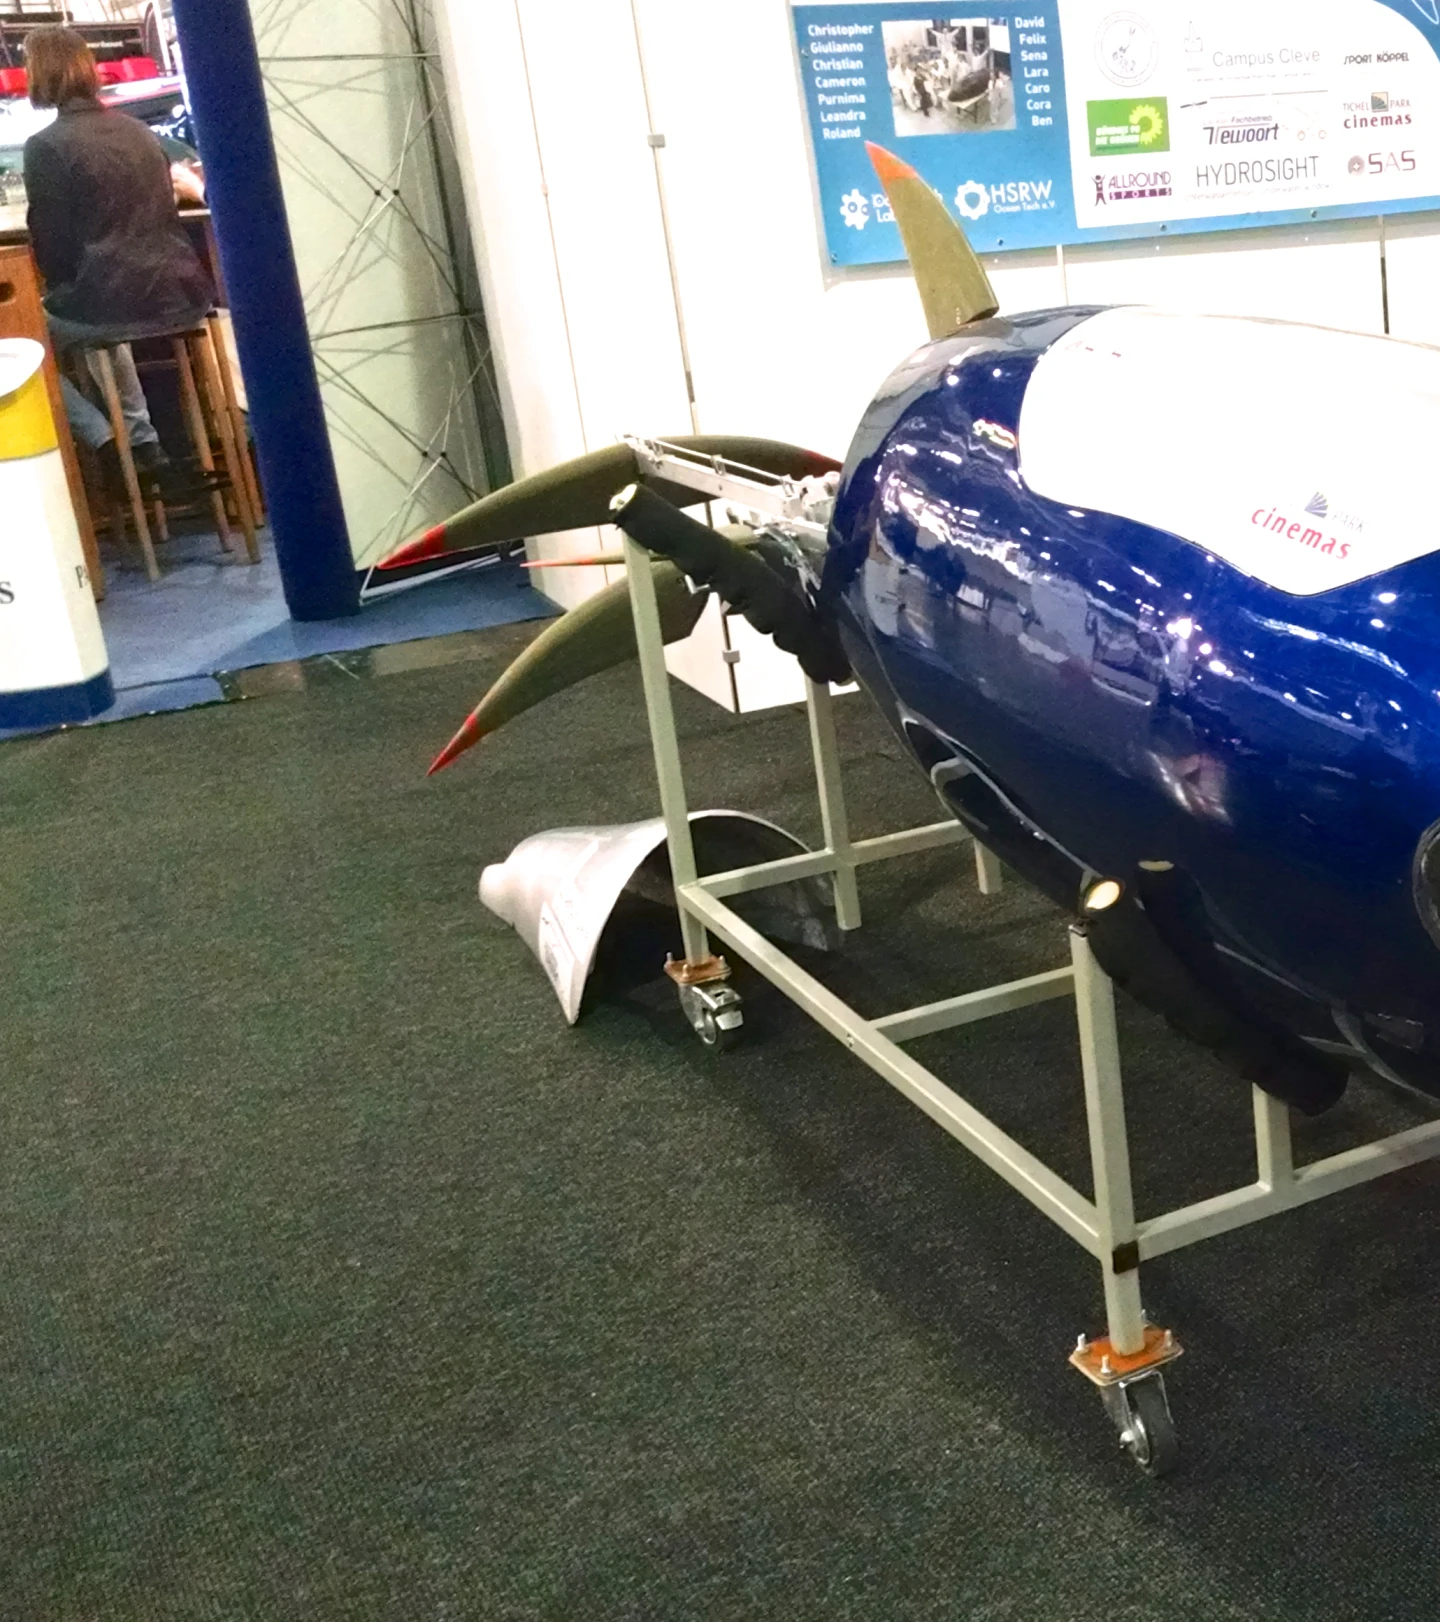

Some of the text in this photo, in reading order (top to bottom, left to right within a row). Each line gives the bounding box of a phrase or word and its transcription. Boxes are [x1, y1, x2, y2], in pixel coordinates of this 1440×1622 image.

[1014, 16, 1044, 28] David
[807, 23, 874, 37] Christopher
[1019, 34, 1047, 45] Felix
[810, 42, 864, 53] Giulianno
[1020, 51, 1048, 61] Sena
[1212, 48, 1321, 67] Campus Cleve
[1376, 50, 1410, 64] KÖPPEL
[813, 59, 863, 71] Christian
[1024, 67, 1049, 77] Lara
[815, 77, 866, 88] Cameron
[1025, 83, 1050, 94] Caro
[818, 93, 866, 105] Purnima
[1026, 99, 1052, 111] Cora
[1342, 98, 1411, 112] TICHEL PARK
[820, 110, 866, 122] Leandra
[1031, 116, 1053, 126] Ben
[1343, 112, 1412, 129] cinemas
[823, 127, 861, 139] Roland
[1368, 150, 1416, 175] SAS
[1196, 155, 1320, 188] HYDROSIGHT
[1108, 171, 1172, 189] ALLROUND
[991, 180, 1053, 203] HSRW
[1110, 188, 1172, 200] SPORTS
[994, 204, 1021, 213] Ocean
[1023, 202, 1040, 211] Tech
[1251, 507, 1352, 560] cinemas
